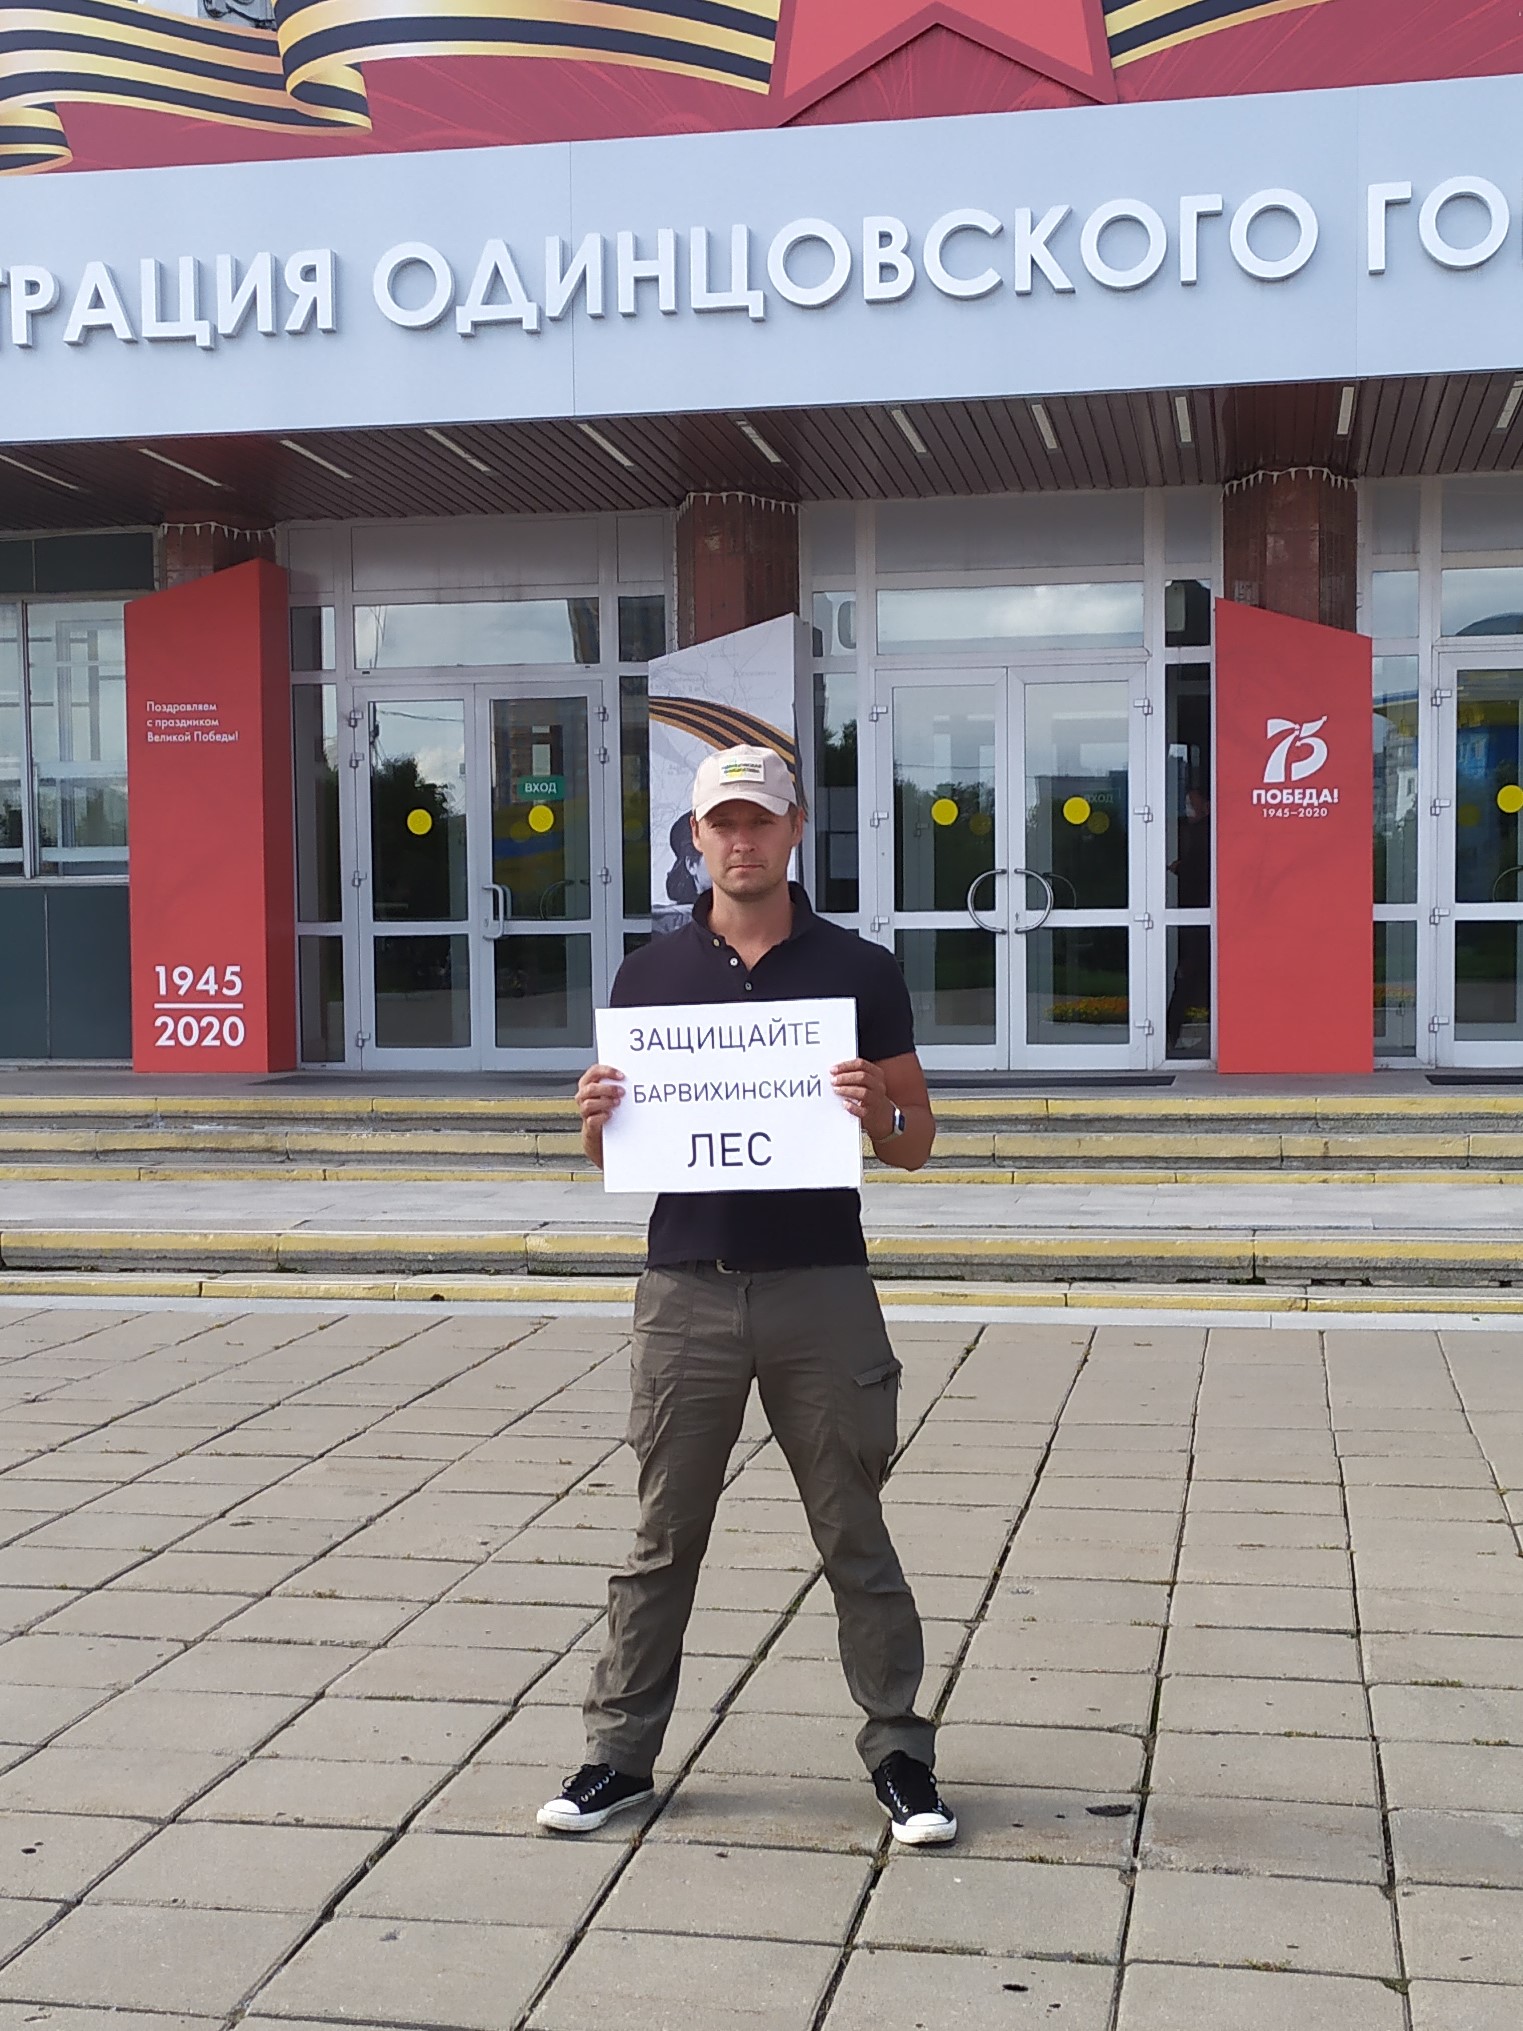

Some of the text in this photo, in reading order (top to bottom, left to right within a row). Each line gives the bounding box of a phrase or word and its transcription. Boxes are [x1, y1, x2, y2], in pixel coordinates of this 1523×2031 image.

[0, 247, 339, 350] РАЦИЯ
[372, 188, 1320, 337] ОДИНЦОВСКОГО
[146, 701, 217, 714] Поздравляем
[146, 718, 219, 730] с праздником
[147, 730, 238, 742] Великой Победы!
[1263, 715, 1328, 783] 75
[524, 782, 557, 794] ВХОД
[1252, 788, 1339, 807] ПОБЕДА!
[154, 965, 243, 996] 1945
[154, 1015, 245, 1047] 2020
[629, 1017, 821, 1054] ЗАЩИЩАЙТЕ
[633, 1074, 822, 1104] БАРВИХИНСКИЙ
[687, 1131, 773, 1168] ЛЕС
